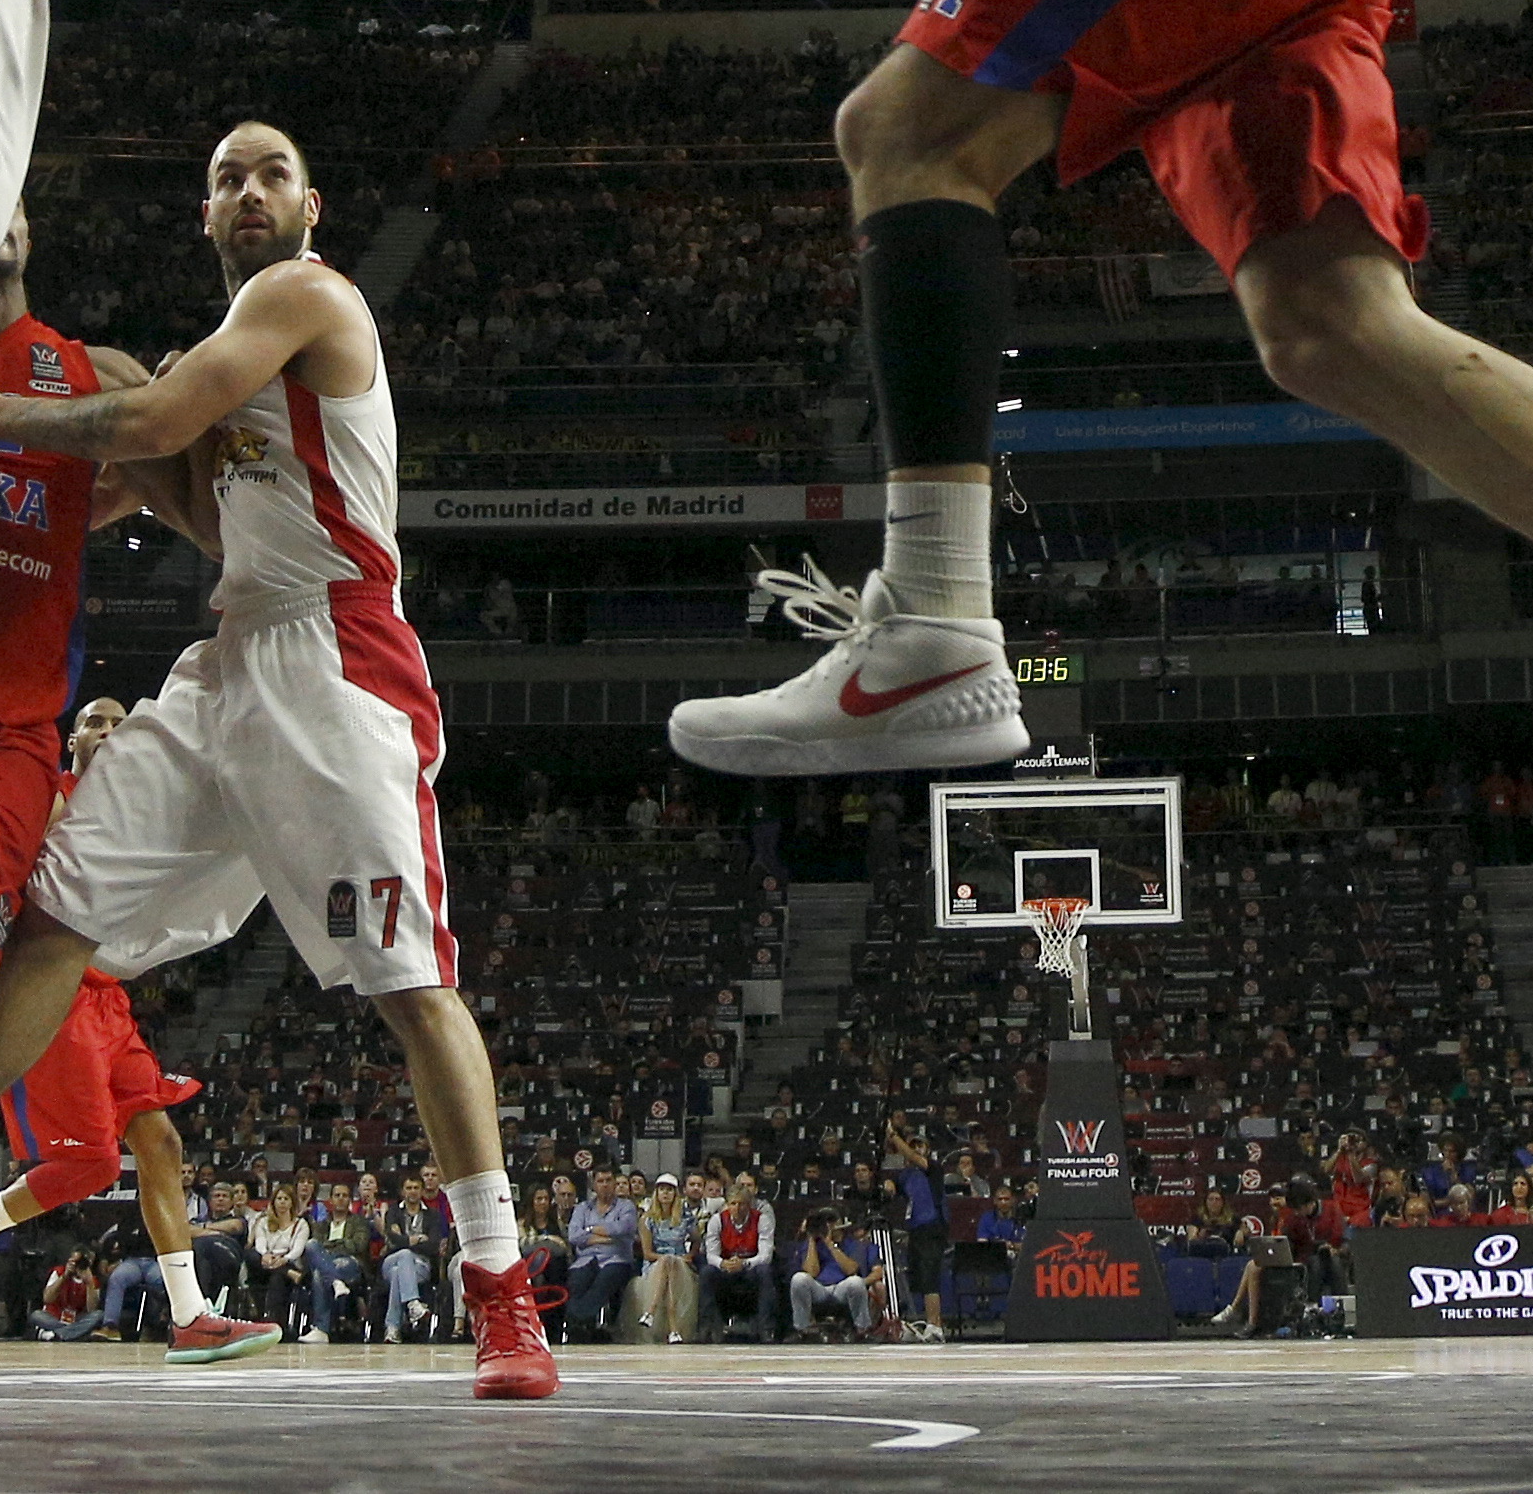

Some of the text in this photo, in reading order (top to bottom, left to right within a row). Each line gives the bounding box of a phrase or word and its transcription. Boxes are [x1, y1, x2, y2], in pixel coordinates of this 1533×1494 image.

[1097, 423, 1177, 437] Barclaycard
[1181, 420, 1256, 433] Experience
[434, 494, 744, 519] Comunidad de Madrid
[1017, 657, 1068, 682] 03:6
[1014, 757, 1090, 768] JACQUES LEMANS
[370, 875, 402, 949] 7
[1048, 1157, 1074, 1165] TURKISH
[1048, 1168, 1119, 1178] FINAL FOUR
[1035, 1262, 1141, 1297] HOME
[1440, 1308, 1472, 1320] TRUE
[1476, 1308, 1491, 1319] TO
[1494, 1307, 1518, 1318] THE
